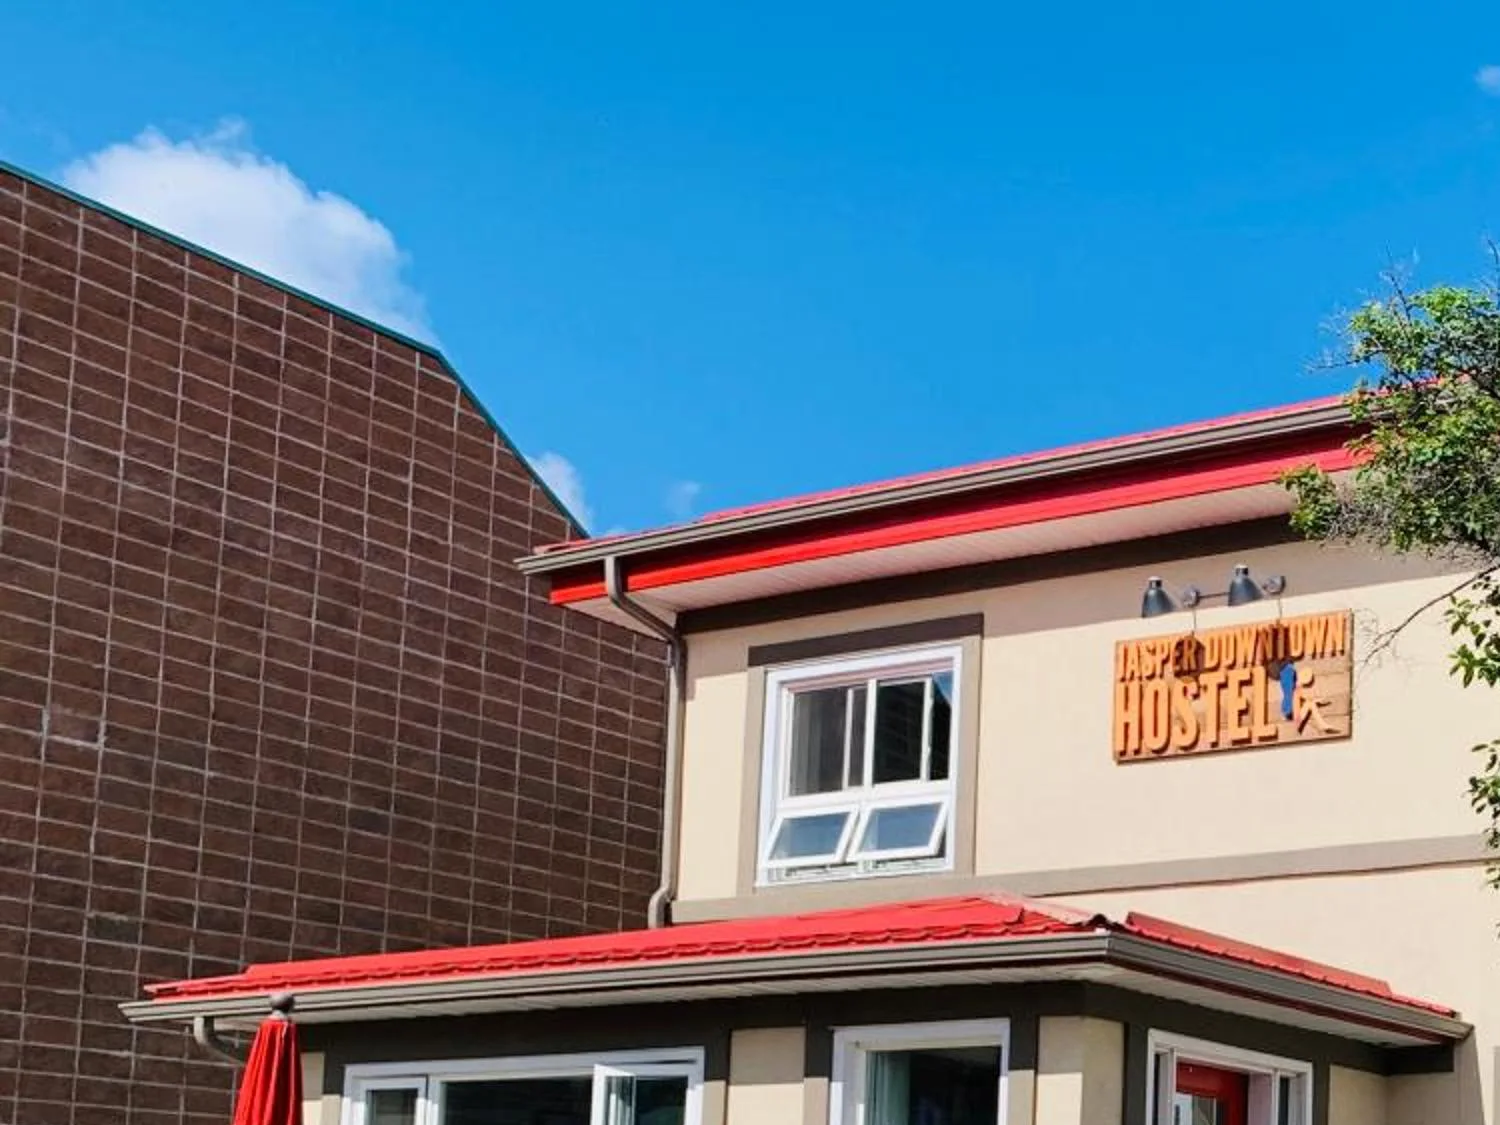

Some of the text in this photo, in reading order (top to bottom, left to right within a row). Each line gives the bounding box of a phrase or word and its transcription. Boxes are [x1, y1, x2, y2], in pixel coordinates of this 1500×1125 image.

[1119, 614, 1347, 682] JASPER DOWNTOWN
[1116, 667, 1278, 756] HOSTEL
